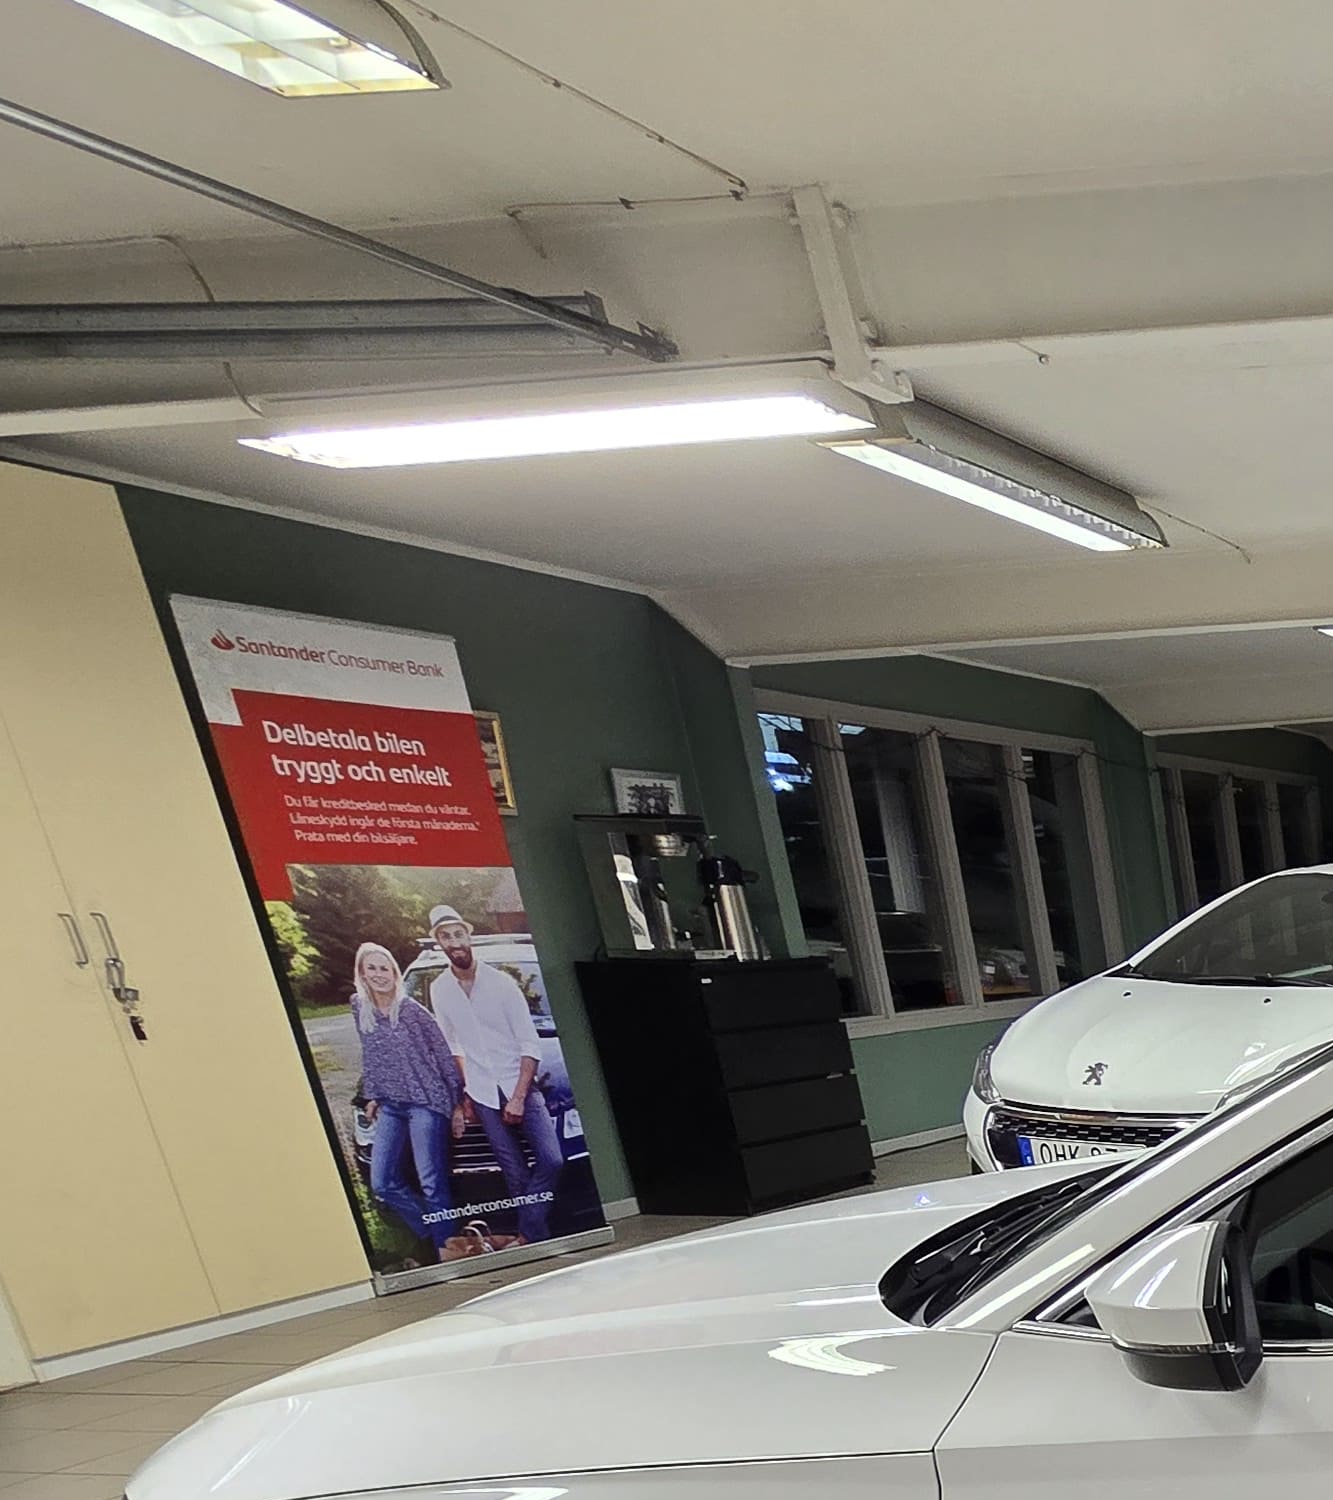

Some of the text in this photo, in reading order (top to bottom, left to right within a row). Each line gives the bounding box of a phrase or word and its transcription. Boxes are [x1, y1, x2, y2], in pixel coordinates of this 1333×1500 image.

[235, 636, 444, 678] Santander Consumer Bank
[261, 720, 426, 756] Delbetala bilen
[271, 754, 452, 787] tryggt och enkelt
[294, 829, 325, 842] Prata
[326, 832, 352, 842] med
[422, 1191, 554, 1224] santanderconsumer.se
